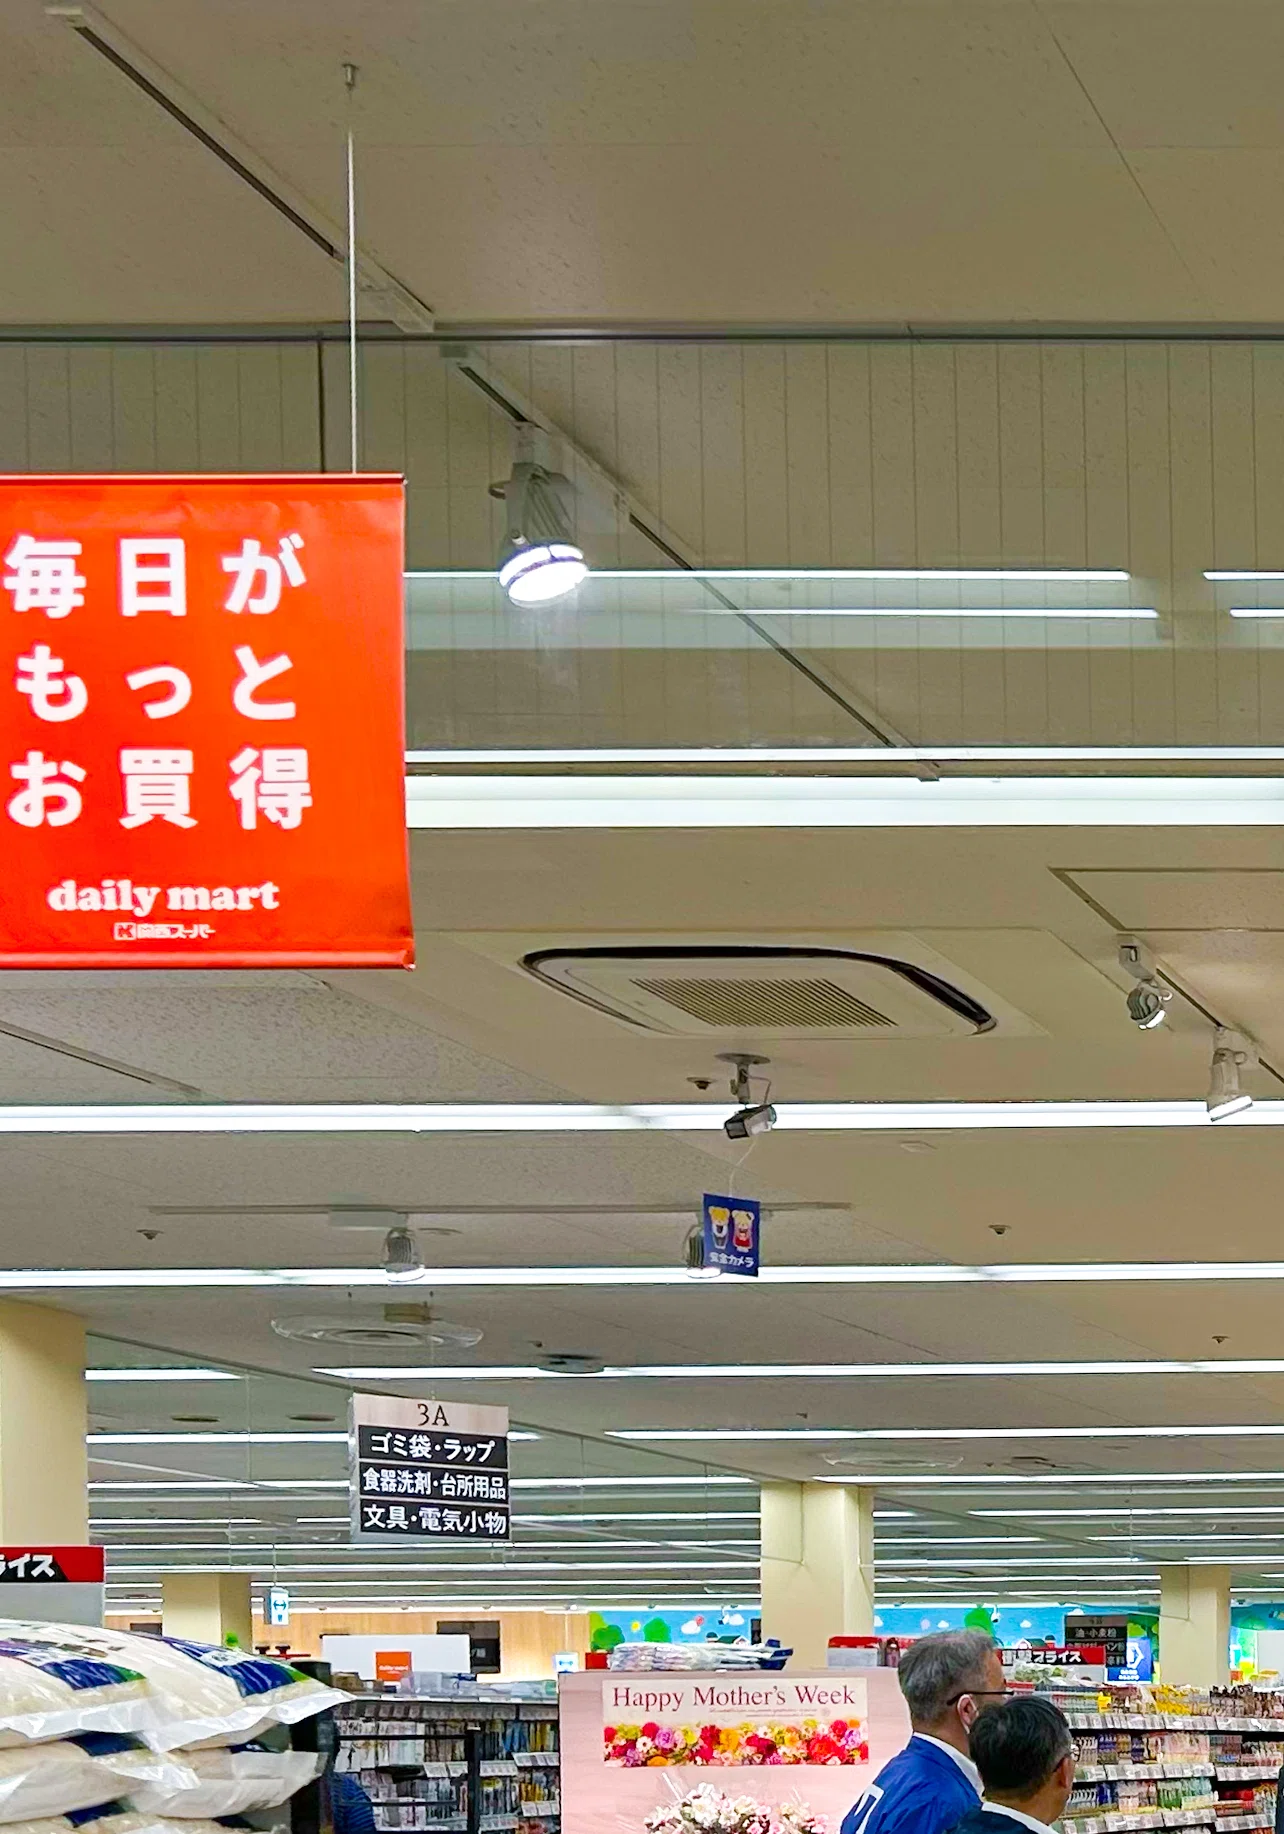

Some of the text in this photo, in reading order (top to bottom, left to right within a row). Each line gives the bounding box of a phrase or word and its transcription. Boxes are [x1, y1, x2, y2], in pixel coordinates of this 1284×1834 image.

[3, 533, 306, 619] 毎日が
[16, 644, 296, 722] もっと
[7, 748, 313, 830] お買得
[47, 879, 280, 915] daily mart
[417, 1403, 449, 1427] 3A
[371, 1432, 496, 1463] ゴミ袋・ラップ
[363, 1467, 506, 1500] 食器洗剤・台所用品
[363, 1504, 507, 1534] 文具・電気小物
[0, 1553, 55, 1578] イス
[613, 1685, 856, 1712] Happy Mother's Week
